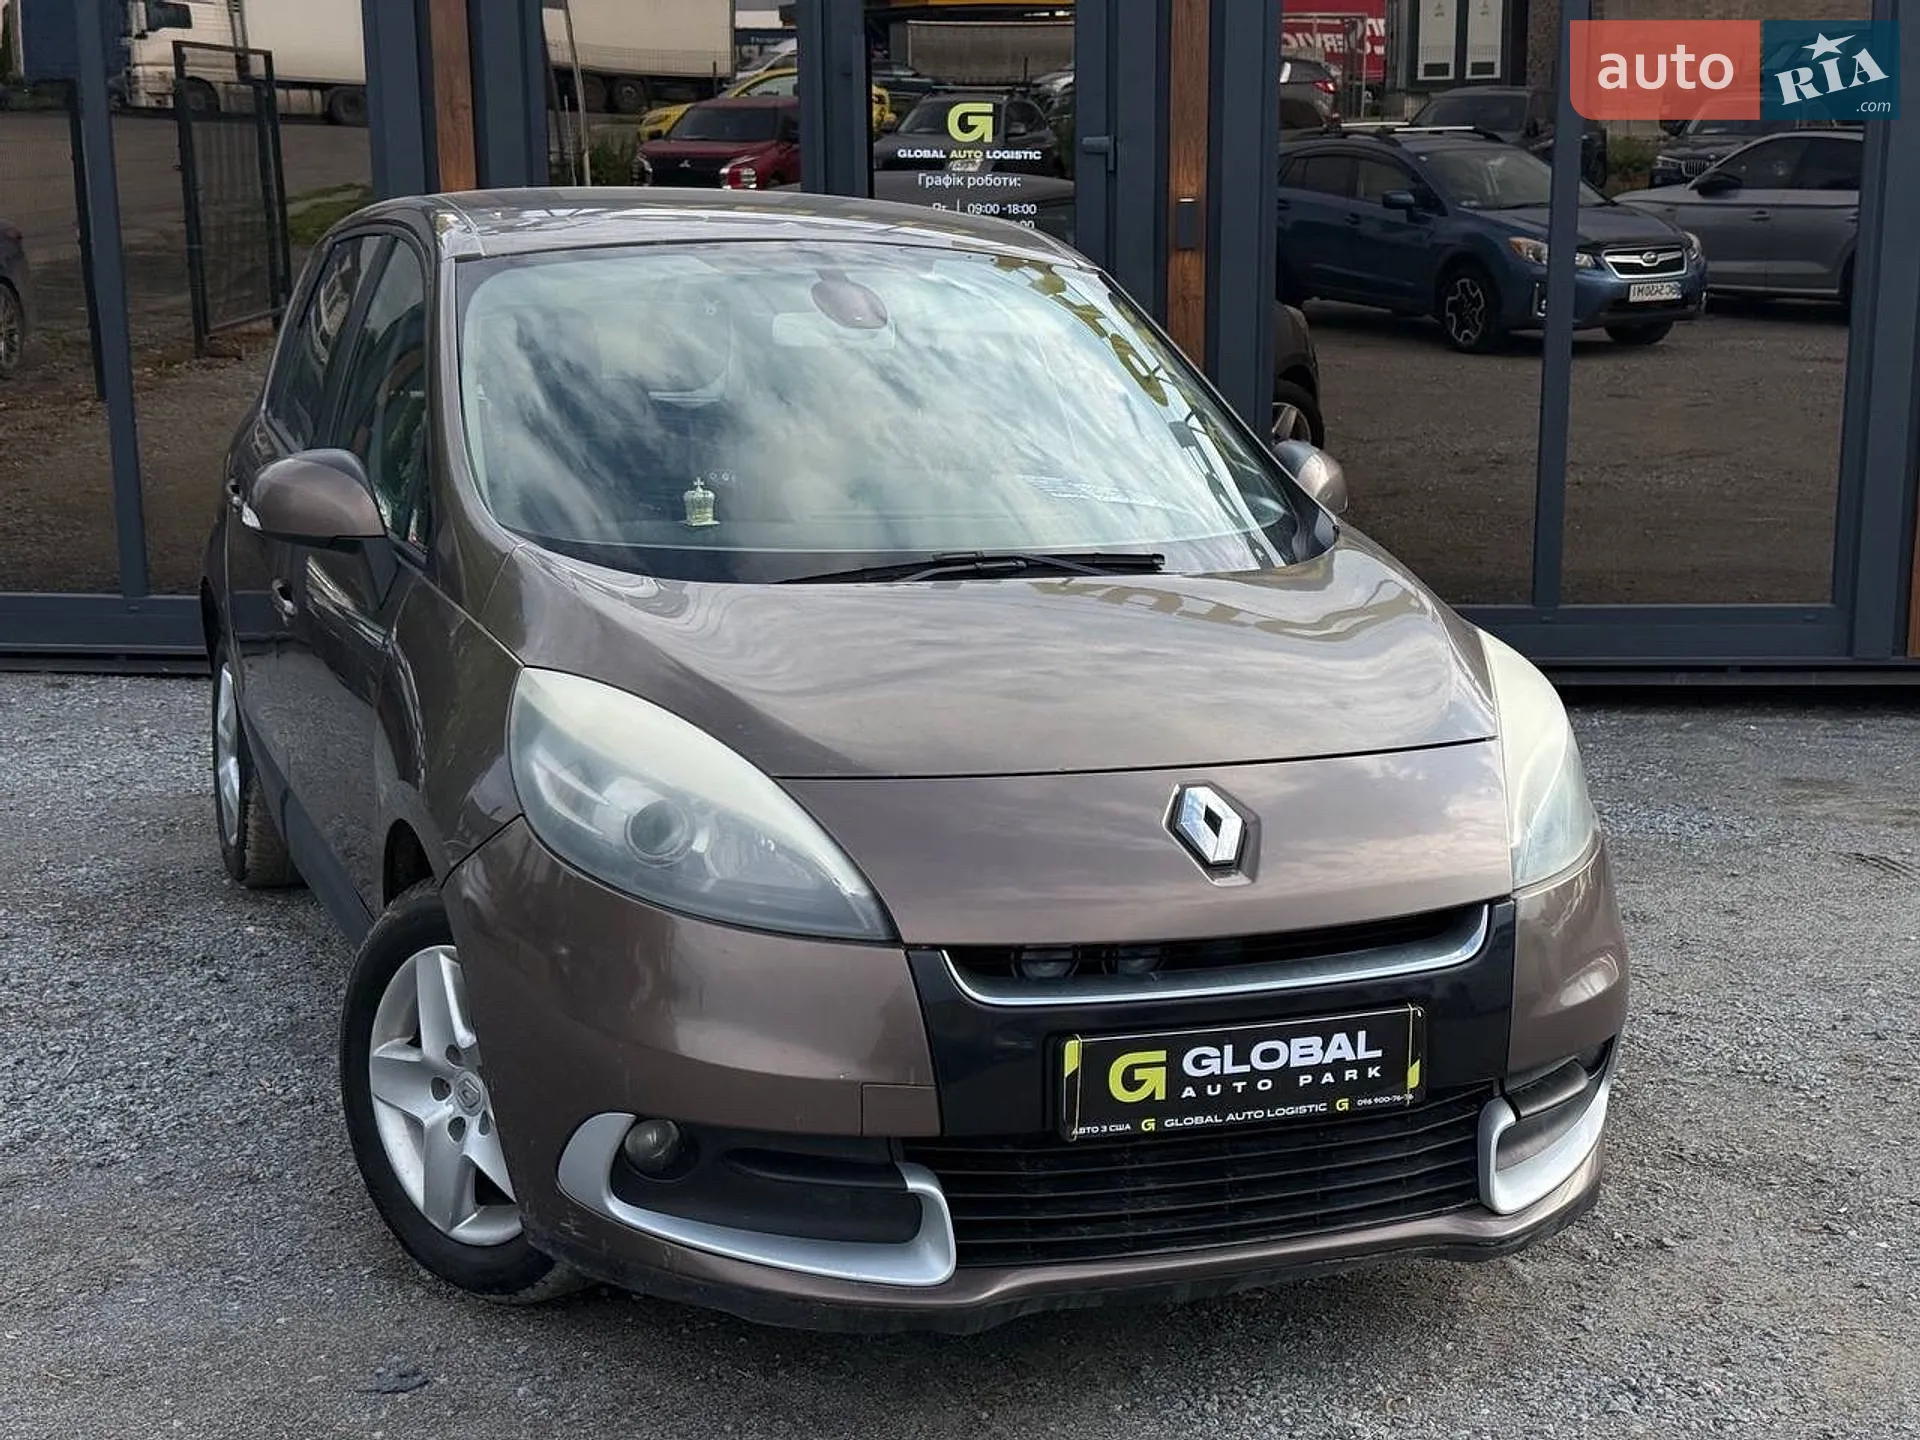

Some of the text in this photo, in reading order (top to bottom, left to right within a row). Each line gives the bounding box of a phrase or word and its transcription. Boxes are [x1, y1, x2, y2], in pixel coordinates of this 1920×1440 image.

[897, 149, 1042, 160] GLOBAL AUTO LOGISTIC
[918, 173, 1022, 189] Графік роботи:
[967, 203, 1000, 215] 09:00
[1180, 1030, 1384, 1078] GLOBAL
[1180, 1066, 1383, 1099] AUTO PARK
[1164, 1103, 1328, 1128] GLOBAL AUTO LOGISTIC
